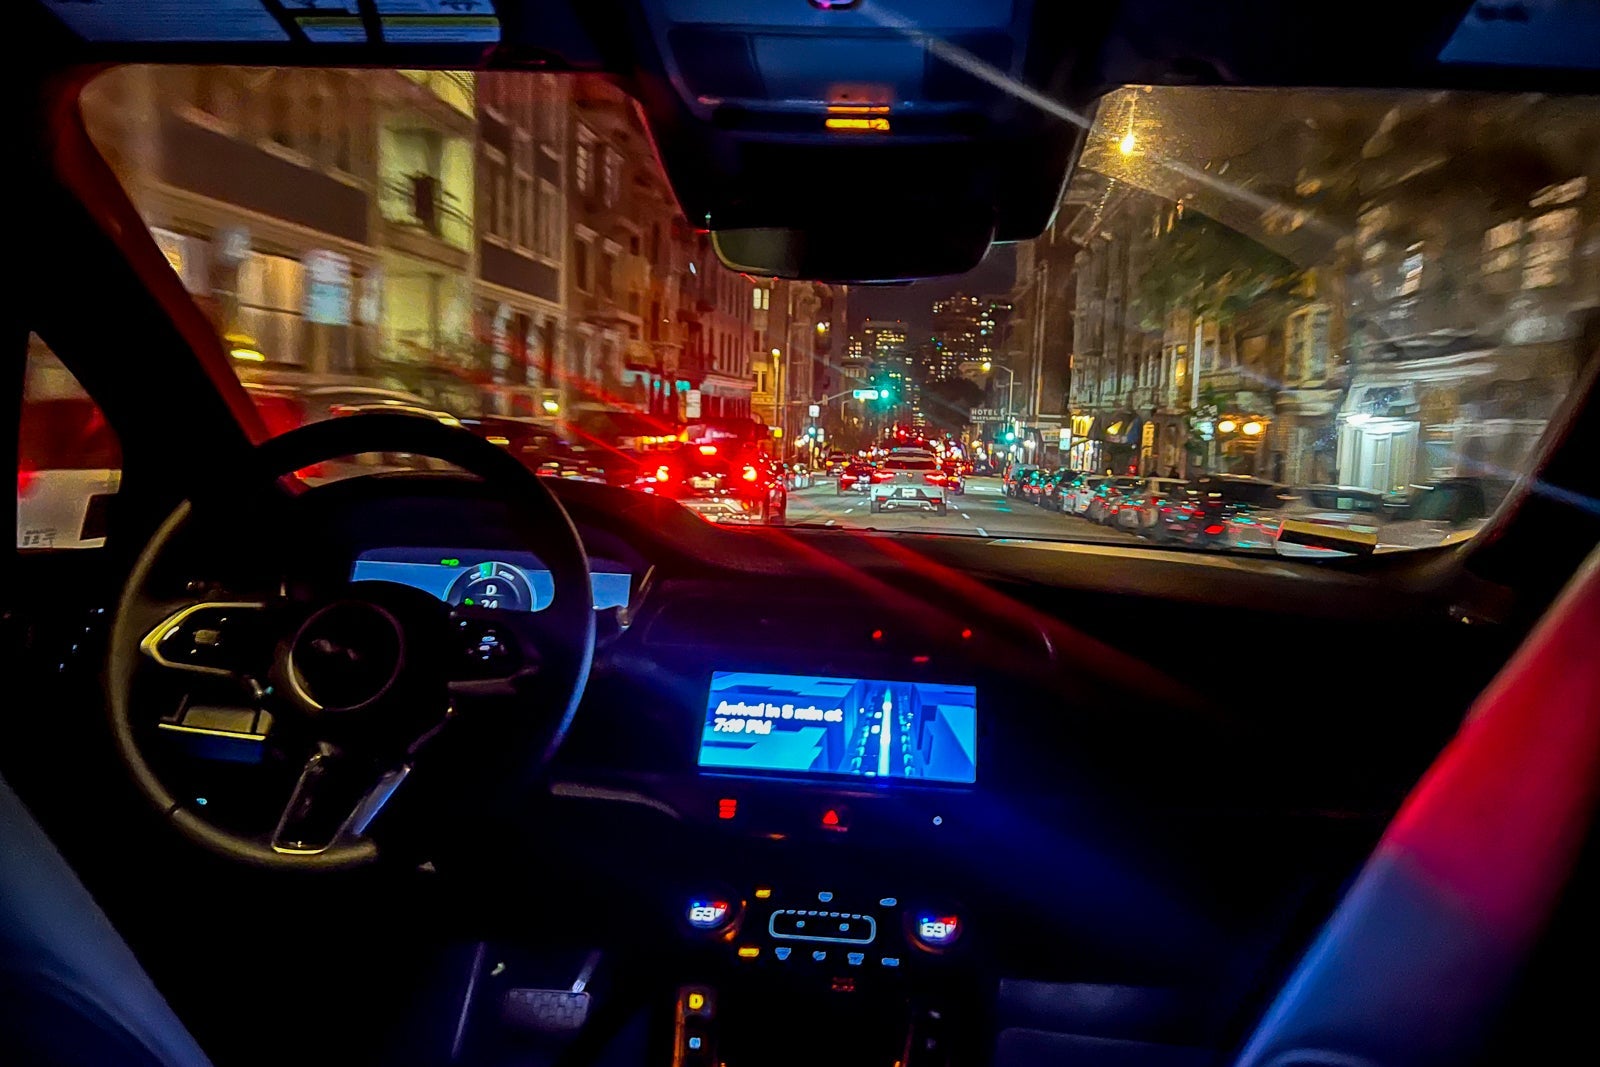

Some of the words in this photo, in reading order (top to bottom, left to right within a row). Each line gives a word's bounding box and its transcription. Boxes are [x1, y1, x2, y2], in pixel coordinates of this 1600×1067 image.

[971, 408, 998, 416] HOTEL
[486, 584, 497, 596] D
[715, 700, 765, 717] Arrival
[765, 703, 781, 718] in
[794, 706, 823, 721] min
[823, 708, 843, 722] at
[745, 719, 772, 735] PM
[689, 993, 704, 1009] D
